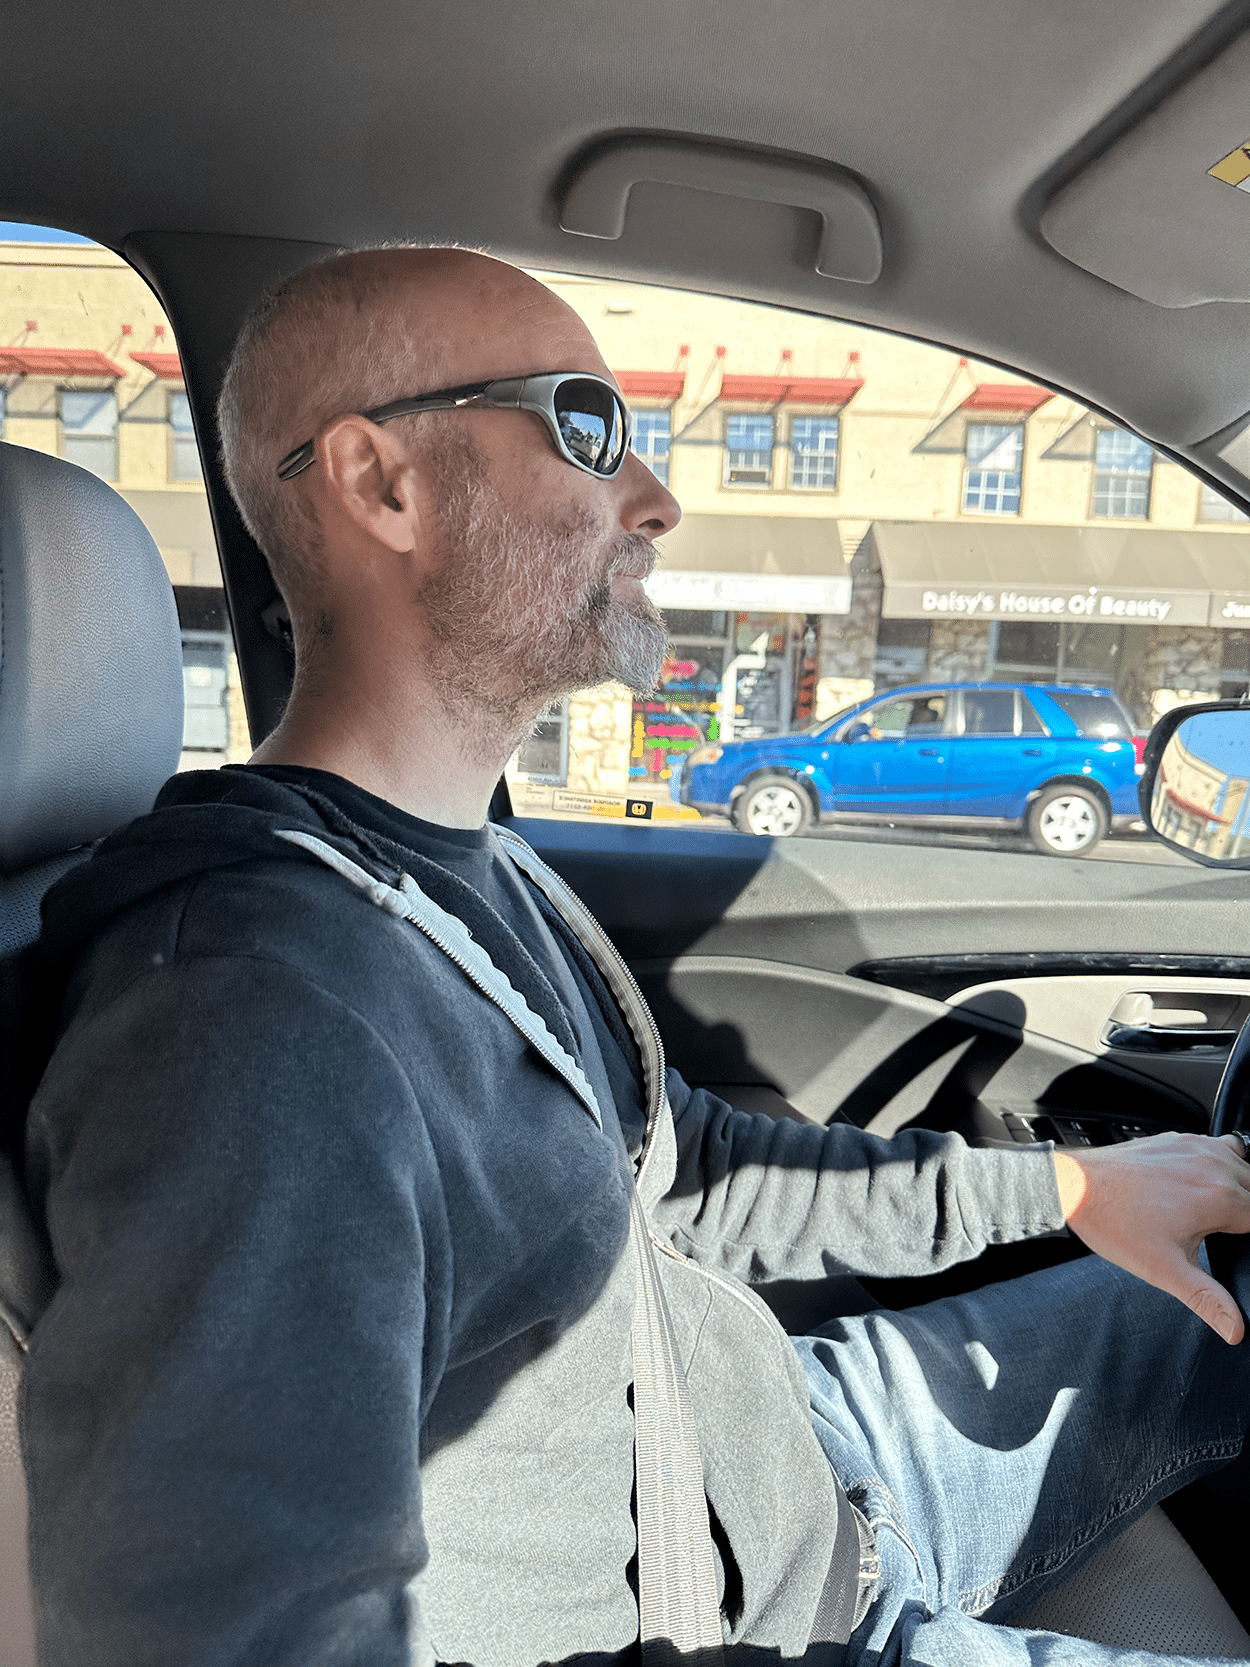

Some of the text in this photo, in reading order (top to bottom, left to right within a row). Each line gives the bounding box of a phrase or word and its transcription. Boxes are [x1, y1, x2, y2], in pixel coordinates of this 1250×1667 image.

[922, 590, 1171, 621] Daisy's House Of Beauty
